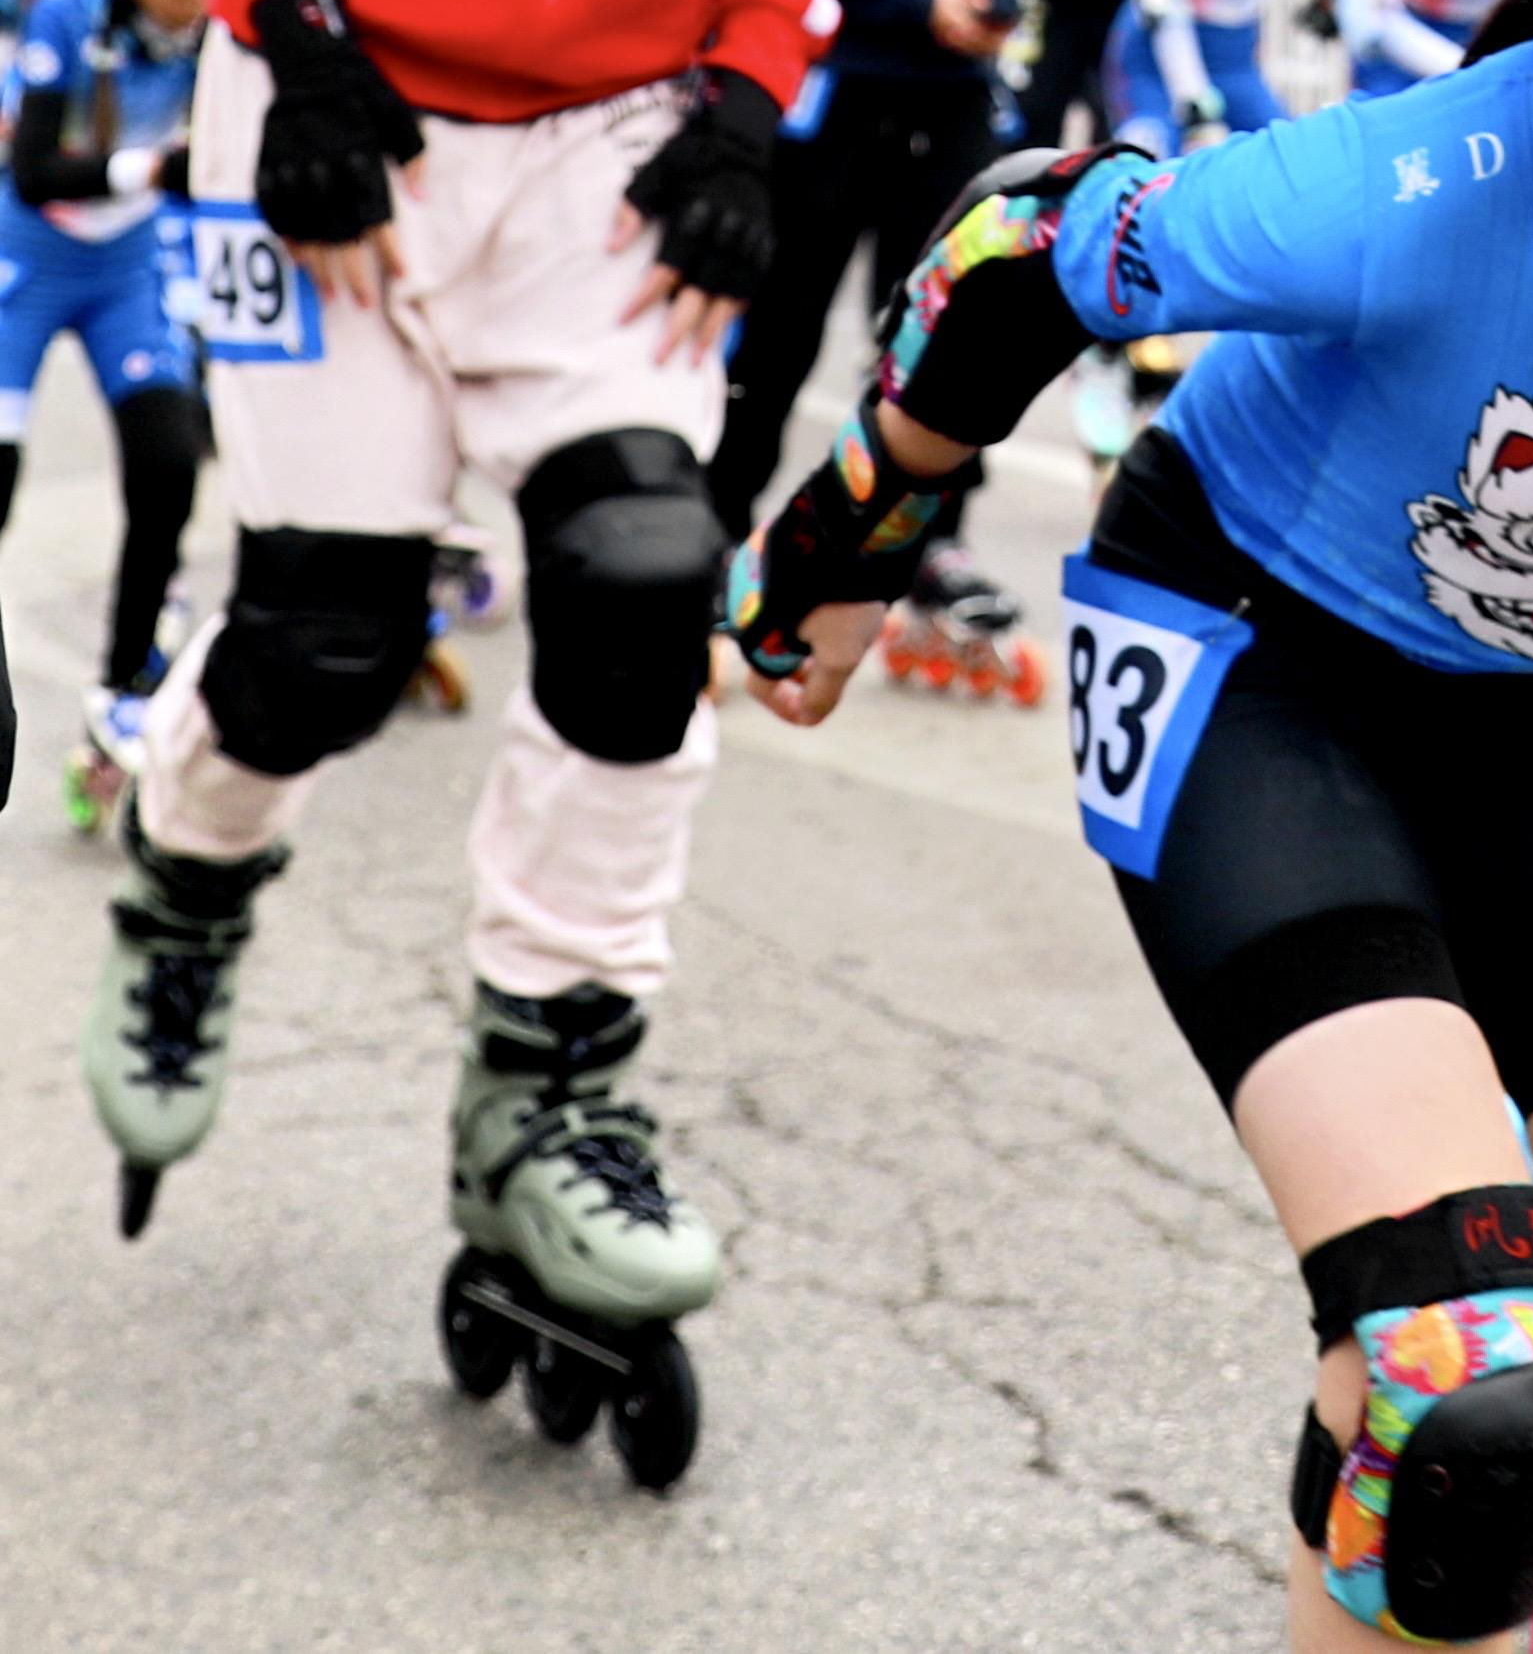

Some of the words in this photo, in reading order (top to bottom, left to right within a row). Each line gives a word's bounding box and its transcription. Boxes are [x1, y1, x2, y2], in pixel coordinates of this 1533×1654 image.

[1465, 132, 1506, 181] D
[208, 236, 284, 324] 49
[1070, 624, 1167, 798] 83
